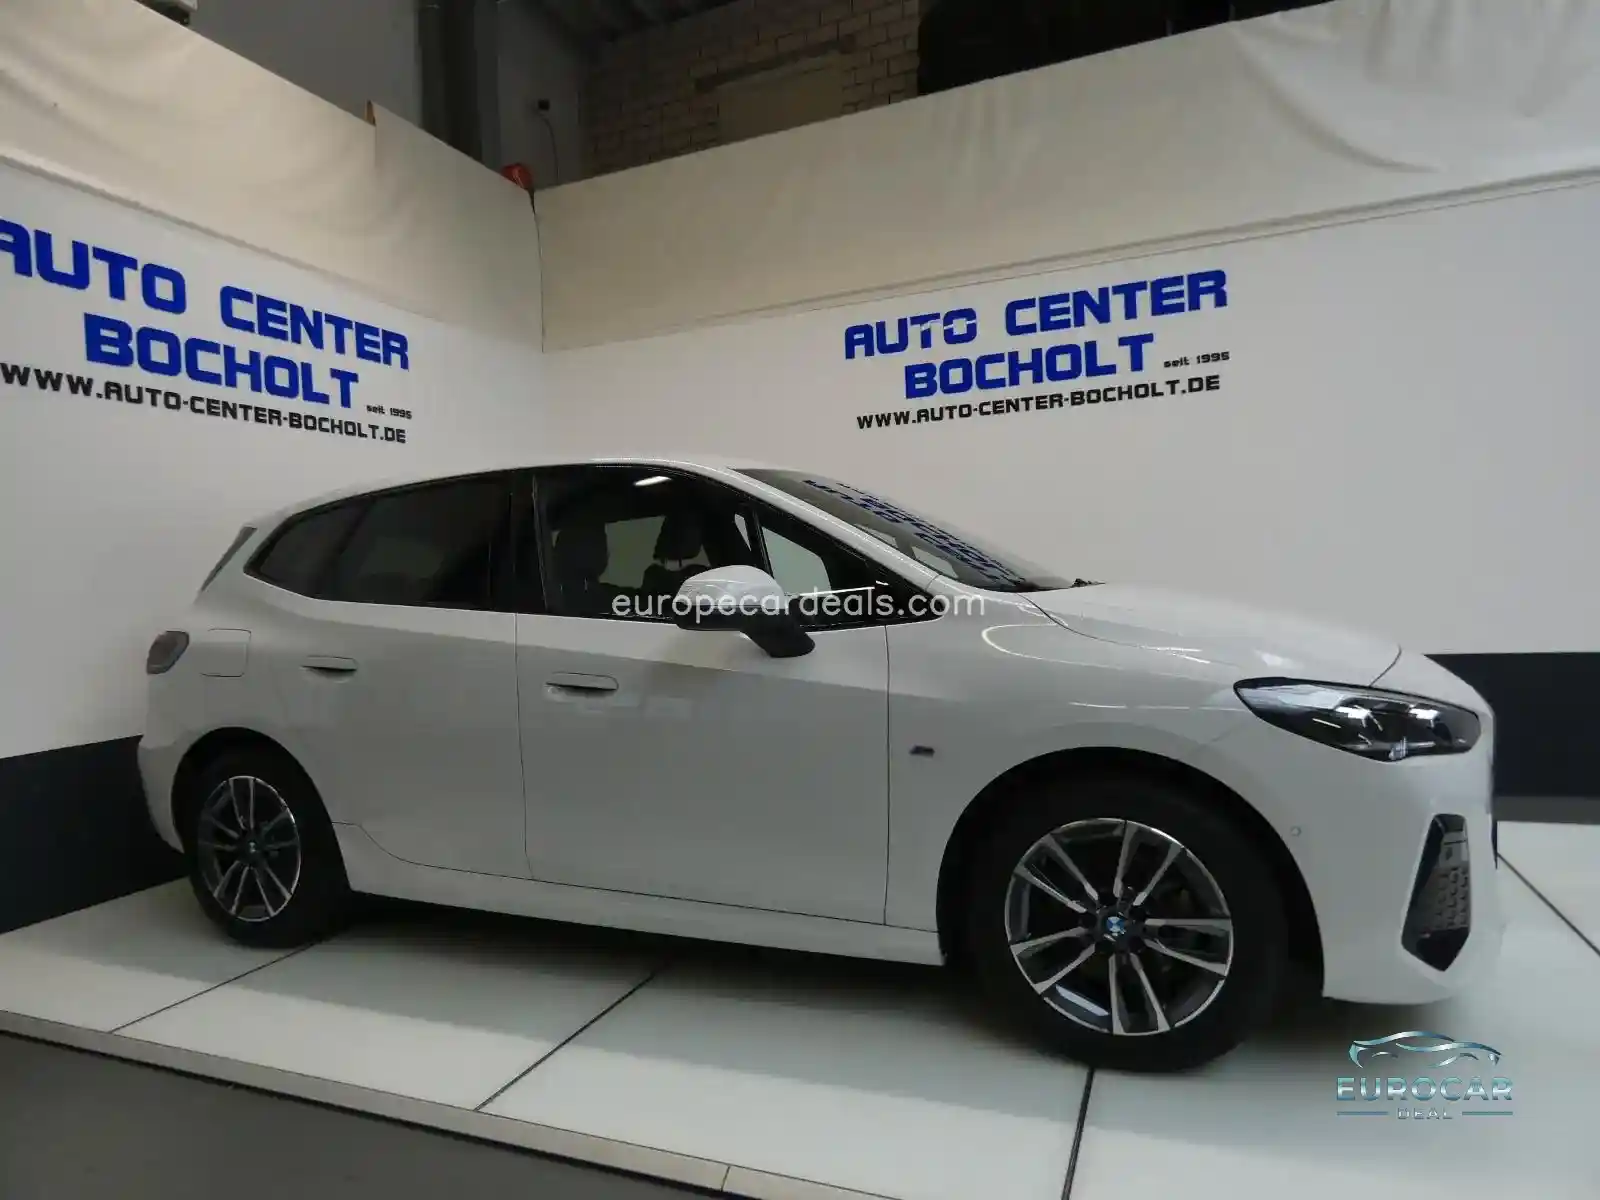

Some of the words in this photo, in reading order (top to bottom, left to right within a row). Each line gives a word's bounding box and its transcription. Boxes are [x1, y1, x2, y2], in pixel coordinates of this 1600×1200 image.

[0, 219, 186, 314] AUTO
[220, 285, 409, 371] CENTER
[845, 308, 976, 359] AUTO
[1005, 270, 1228, 337] CENTER
[84, 313, 359, 409] BOCHOLT
[905, 333, 1154, 399] BOCHOLT
[1163, 356, 1190, 368] seit
[1196, 351, 1230, 364] 1995
[0, 362, 406, 444] WWW.AUTO-CENTER-BOCHOLT.DE
[390, 407, 412, 420] 1995
[856, 374, 1221, 430] WWW.AUTO-CENTER-BOCHOLT.DE
